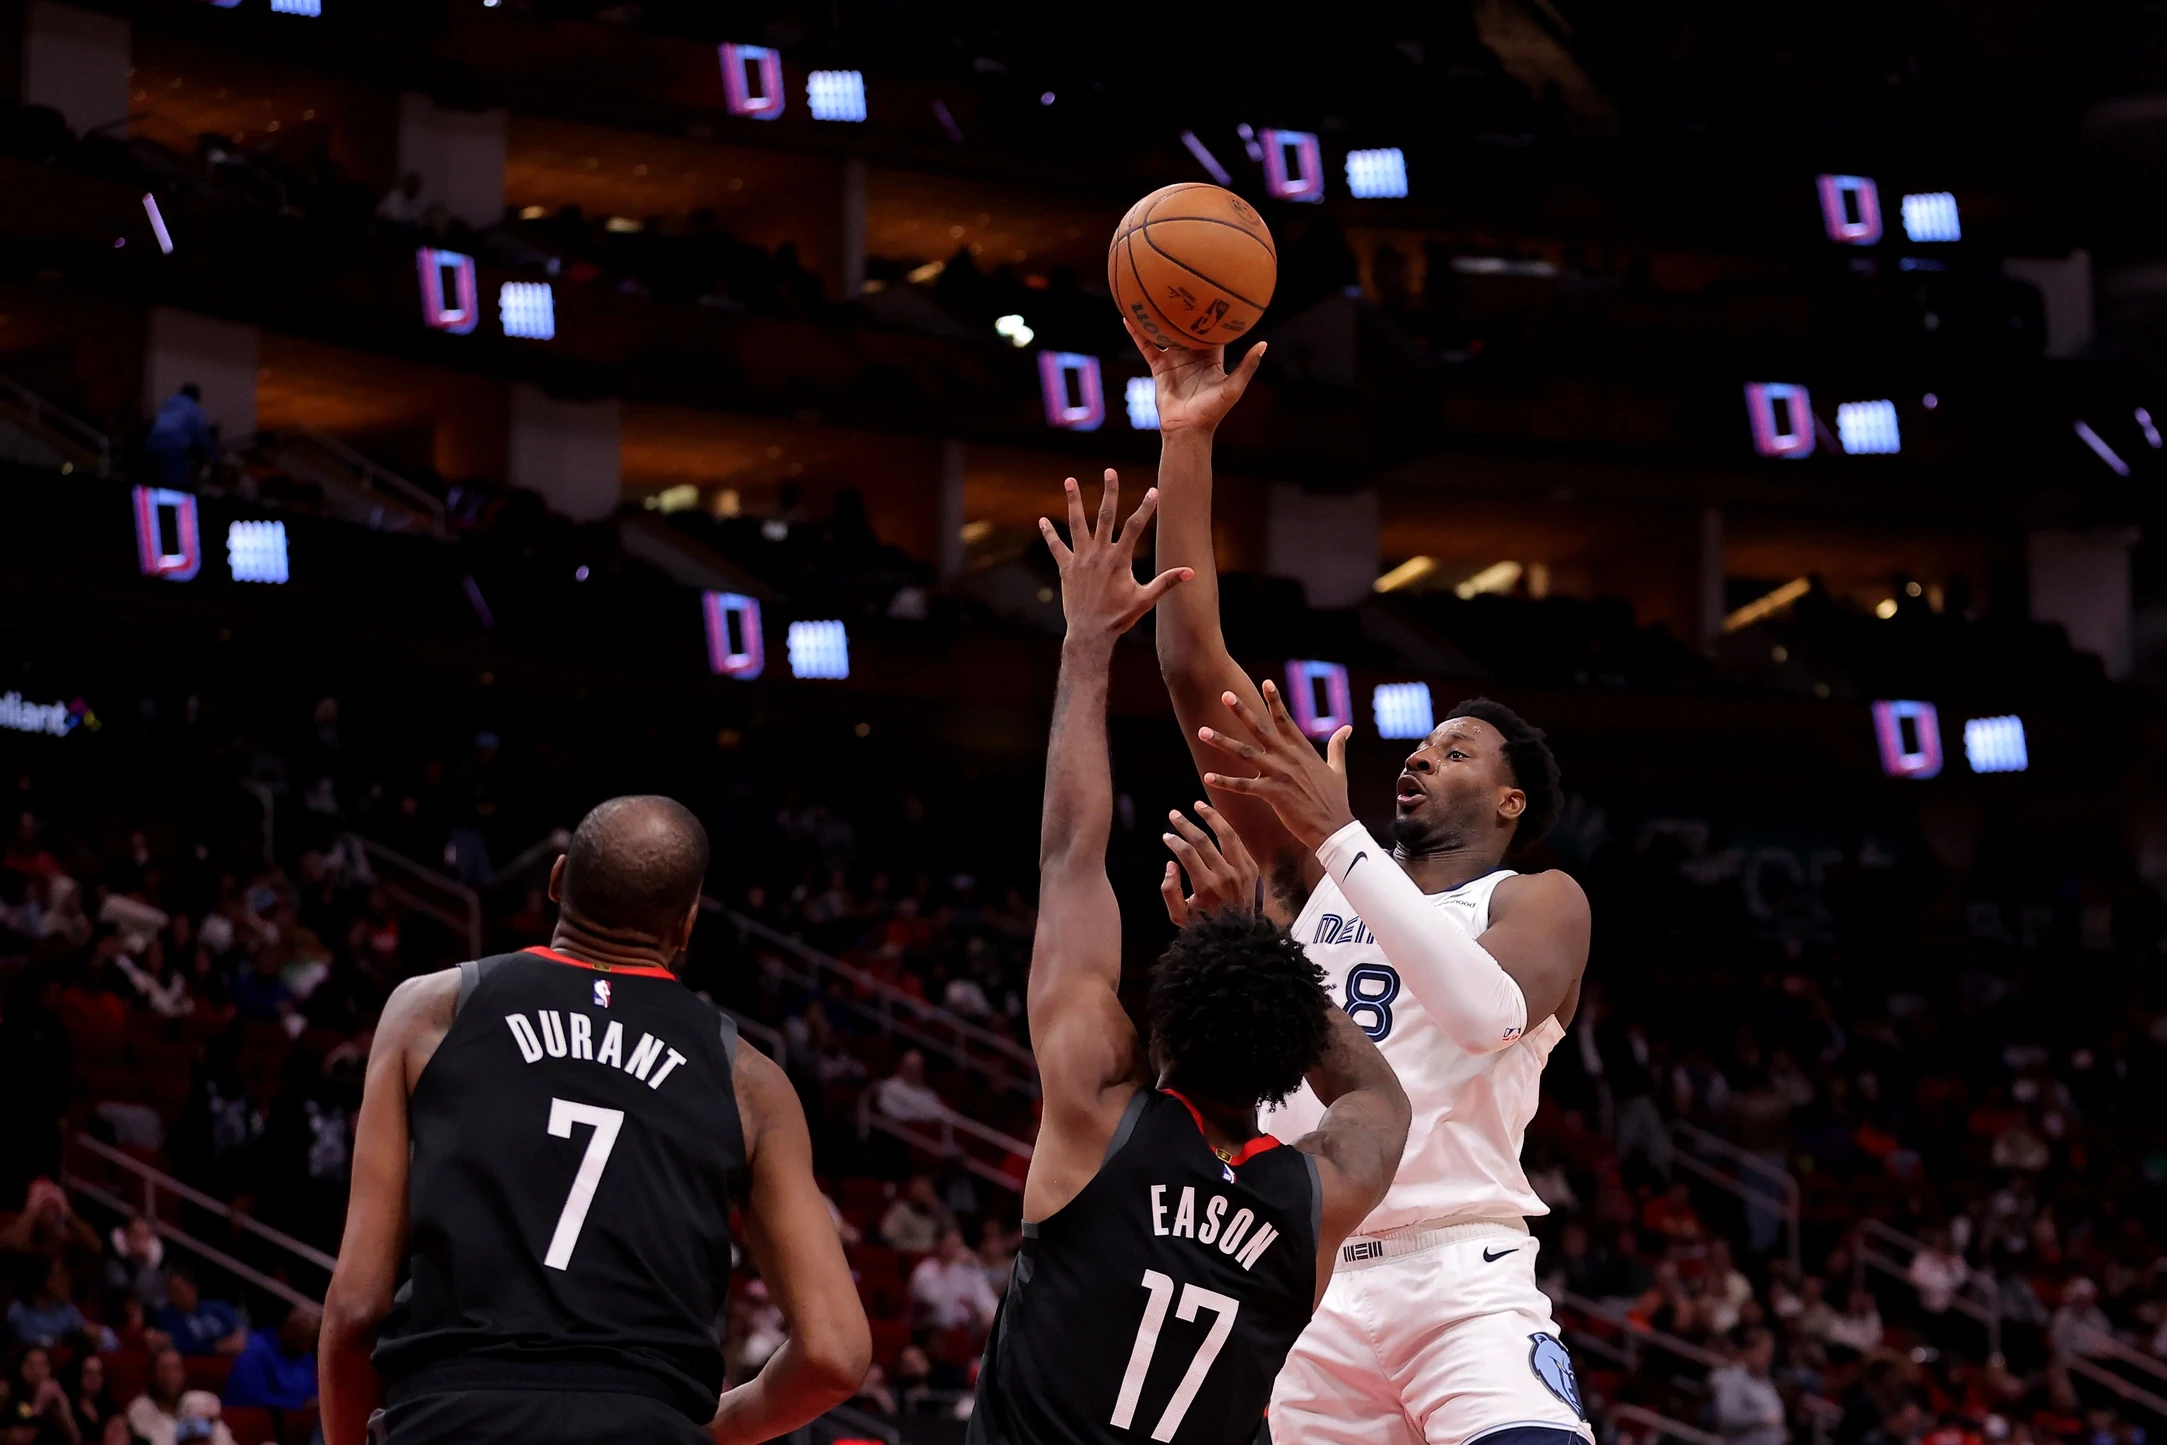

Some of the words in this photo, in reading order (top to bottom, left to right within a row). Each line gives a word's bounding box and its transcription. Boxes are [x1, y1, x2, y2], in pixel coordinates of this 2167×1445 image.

[1312, 913, 1377, 945] MEM
[1343, 962, 1402, 1043] 8
[505, 1010, 688, 1090] DURANT
[544, 1097, 625, 1271] 7
[1150, 1184, 1280, 1272] EASON
[1109, 1268, 1240, 1444] 17
